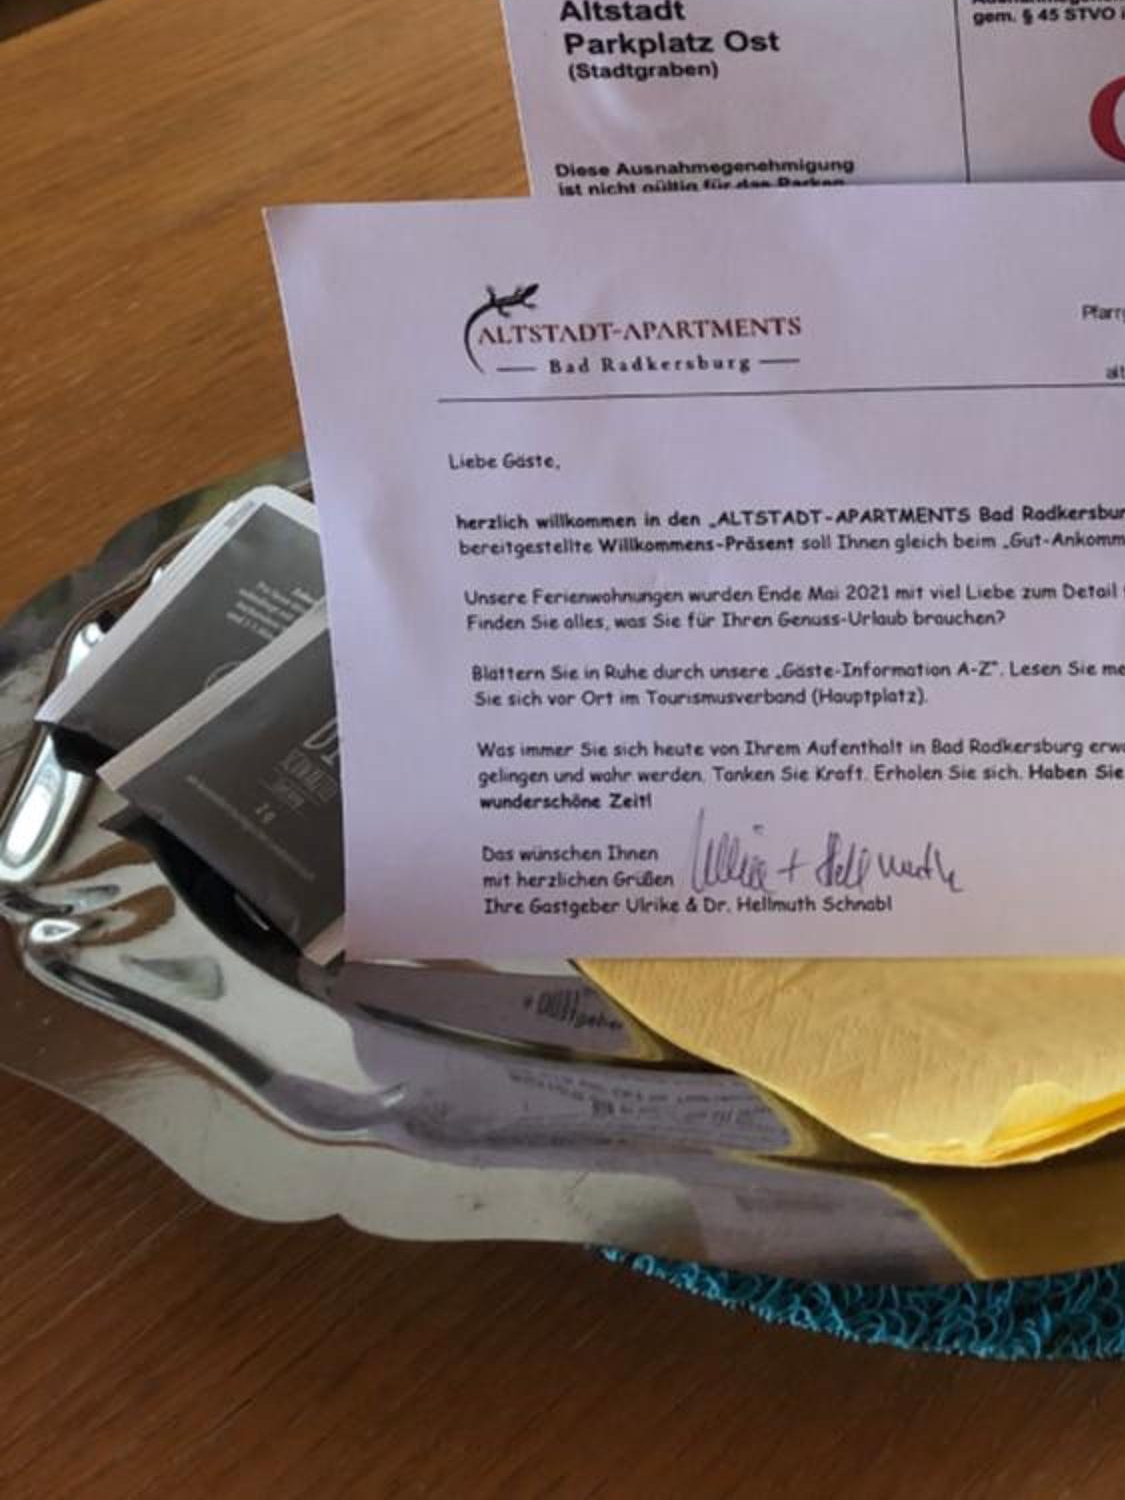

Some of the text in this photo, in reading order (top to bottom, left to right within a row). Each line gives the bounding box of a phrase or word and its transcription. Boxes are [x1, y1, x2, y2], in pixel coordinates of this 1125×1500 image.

[972, 10, 1017, 28] gem.
[1021, 7, 1034, 26] §
[1037, 6, 1061, 22] 45
[1064, 6, 1117, 23] STVO
[563, 29, 780, 59] Parkplatz Ost
[568, 60, 719, 83] (Stadtgraben)
[554, 158, 855, 178] Diese Ausnahmegenehmigung
[558, 182, 583, 197] ist
[588, 181, 636, 196] nicht
[477, 316, 804, 346] ALTSTADT-APARTMENTS
[549, 354, 751, 375] Bad Radkersburg
[448, 451, 561, 471] Liebe Gäste,
[455, 513, 529, 531] herzlich
[535, 512, 637, 530] willkommen
[644, 512, 661, 528] in
[667, 510, 701, 527] den
[978, 505, 1014, 523] Bad
[458, 537, 593, 559] bereitgestellte
[597, 534, 795, 554] Willkommens-Präsent
[801, 534, 832, 551] soll
[837, 533, 891, 551] Ihnen
[894, 531, 948, 555] gleich
[953, 532, 997, 550] beim
[463, 590, 527, 606] Unsere
[532, 587, 684, 609] Ferienwohnungen
[688, 586, 754, 603] wurden
[757, 584, 802, 603] Ende
[807, 585, 840, 602] Mai
[845, 583, 889, 601] 2021
[894, 586, 924, 601] mit
[929, 583, 961, 601] viel
[965, 583, 1015, 601] Liebe
[1021, 586, 1057, 601] zum
[1062, 582, 1118, 600] Detail
[466, 608, 1006, 632] Finden Sie alles, was Sie für Ihren Genuss-Urlaub brauchen?
[471, 664, 546, 682] Blättern
[551, 664, 579, 681] Sie
[583, 668, 601, 681] in
[604, 663, 648, 681] Ruhe
[652, 662, 705, 681] durch
[709, 666, 769, 680] unsere
[956, 659, 1004, 677] A-Z“.
[1009, 660, 1062, 678] Lesen
[1067, 659, 1097, 677] Sie
[474, 686, 928, 709] Sie sich vor Ort im Tourismusverband (Hauptplatz).
[476, 741, 515, 758] Was
[519, 744, 574, 758] immer
[580, 741, 608, 758] Sie
[613, 740, 649, 758] sich
[653, 740, 705, 757] heute
[709, 743, 740, 757] von
[744, 739, 801, 757] Ihrem
[806, 737, 903, 757] Aufenthalt
[909, 742, 926, 755] in
[931, 737, 964, 756] Bad
[968, 737, 1084, 759] Radkersburg
[478, 767, 549, 789] gelingen
[553, 766, 584, 784] und
[589, 766, 632, 784] wahr
[637, 766, 706, 784] werden.
[712, 765, 775, 783] Tanken
[781, 765, 809, 783] Sie
[815, 763, 868, 782] Kraft.
[874, 763, 943, 783] Erholen
[948, 764, 977, 781] Sie
[982, 763, 1023, 781] sich.
[1028, 763, 1088, 781] Haben
[1095, 763, 1125, 781] Sie
[479, 792, 652, 810] wunderschöne Zeit!
[481, 843, 659, 863] Das wünschen Ihnen
[482, 869, 675, 889] mit herzlichen Grüßen
[484, 894, 893, 920] Ihre Gastgeber Ulrike & Dr. Hellmuth Schnabl
